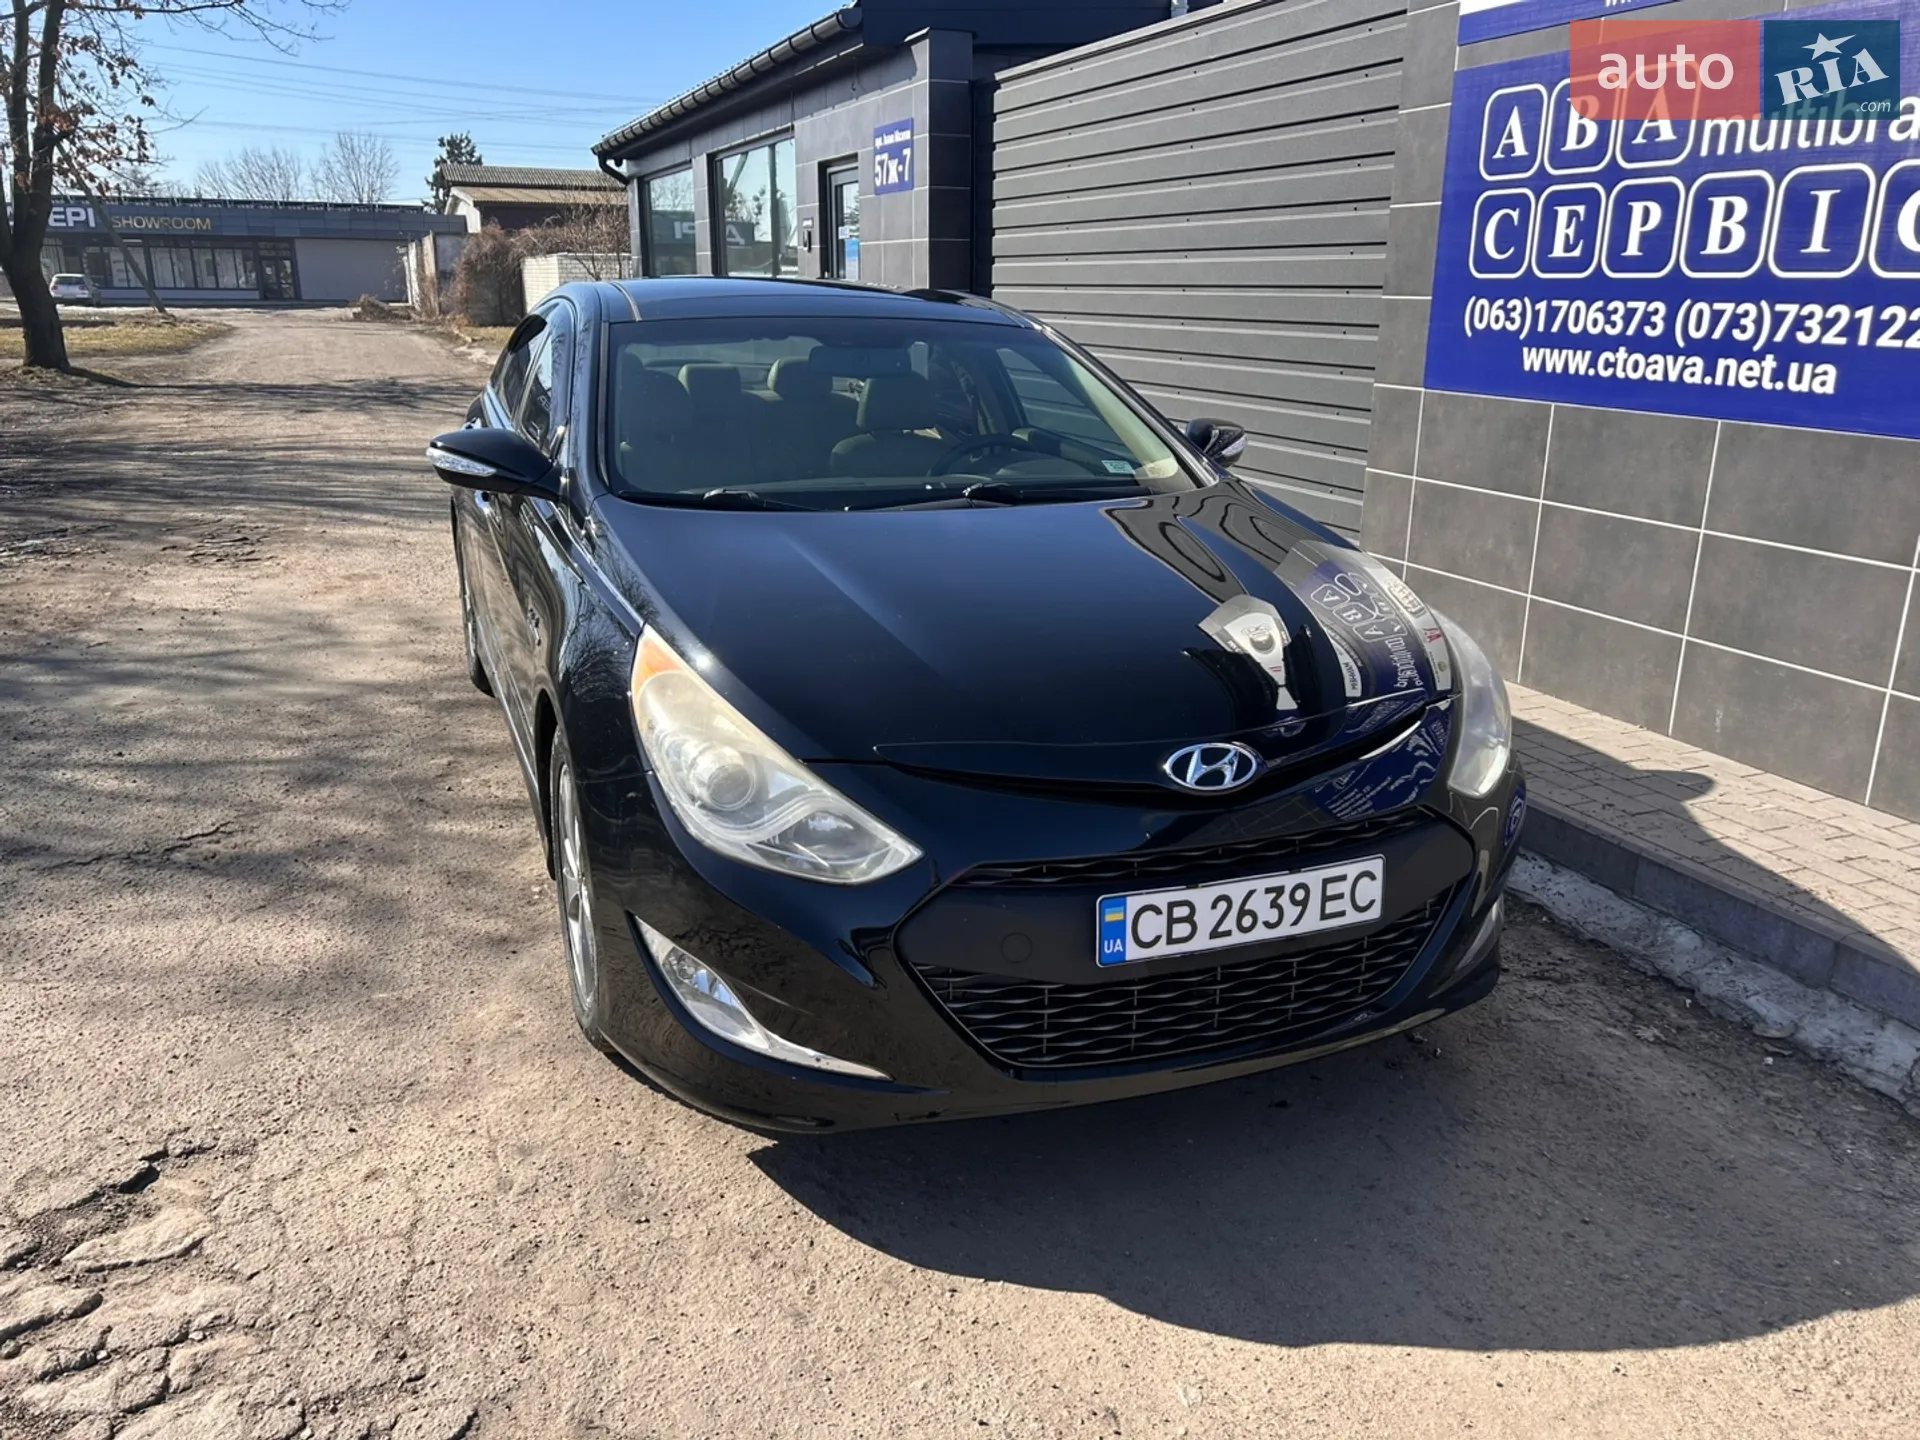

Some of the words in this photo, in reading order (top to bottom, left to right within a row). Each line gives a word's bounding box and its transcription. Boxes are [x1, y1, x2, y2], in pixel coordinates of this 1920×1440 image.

[112, 215, 211, 230] SHOWROOM
[1464, 296, 1666, 340] (063)1706373
[1522, 345, 1838, 395] www.ctoava.net.ua
[1131, 899, 1198, 949] CB
[1209, 882, 1311, 940] 2639
[1319, 870, 1377, 921] EC
[1104, 939, 1123, 954] UA
